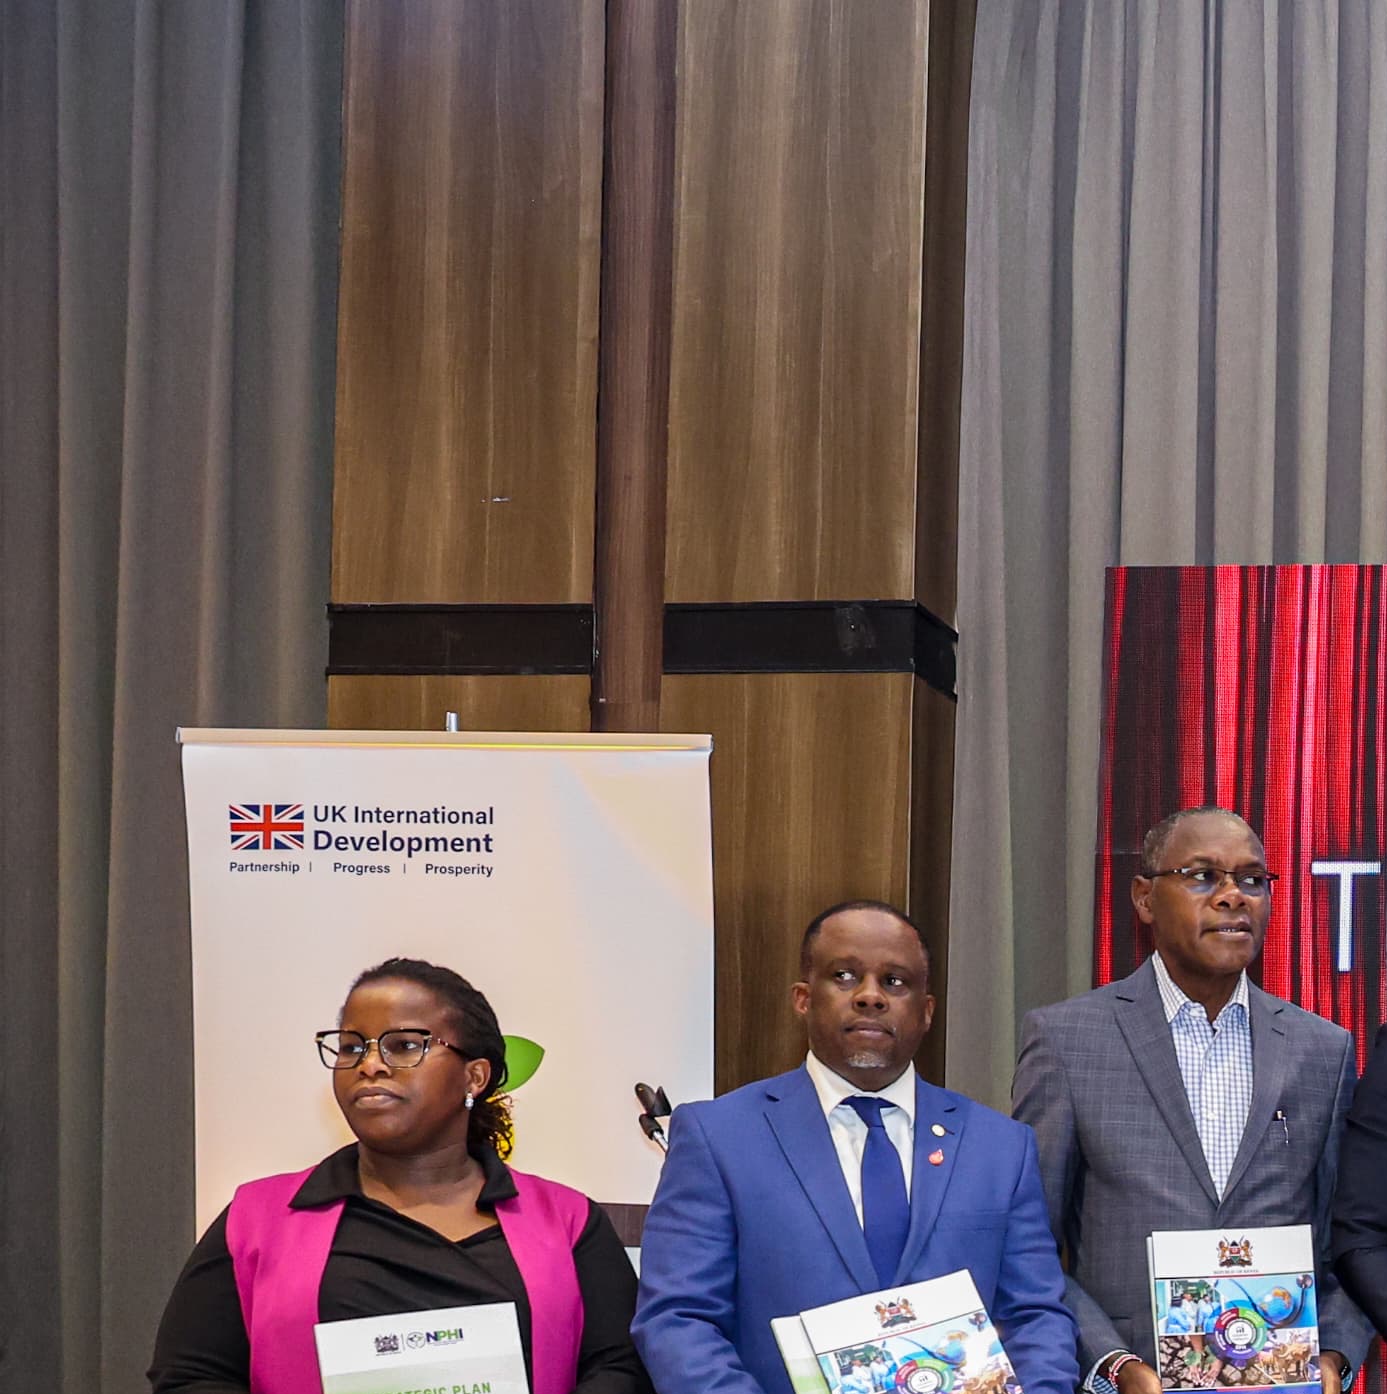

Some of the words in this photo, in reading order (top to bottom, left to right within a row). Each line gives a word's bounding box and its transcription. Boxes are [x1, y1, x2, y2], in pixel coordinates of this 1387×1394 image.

[313, 805, 347, 824] UK
[353, 806, 494, 825] International
[313, 830, 494, 857] Development
[229, 861, 300, 875] Partnership
[333, 862, 391, 876] Progress
[425, 863, 494, 877] Prosperity
[425, 1328, 463, 1342] NPHI
